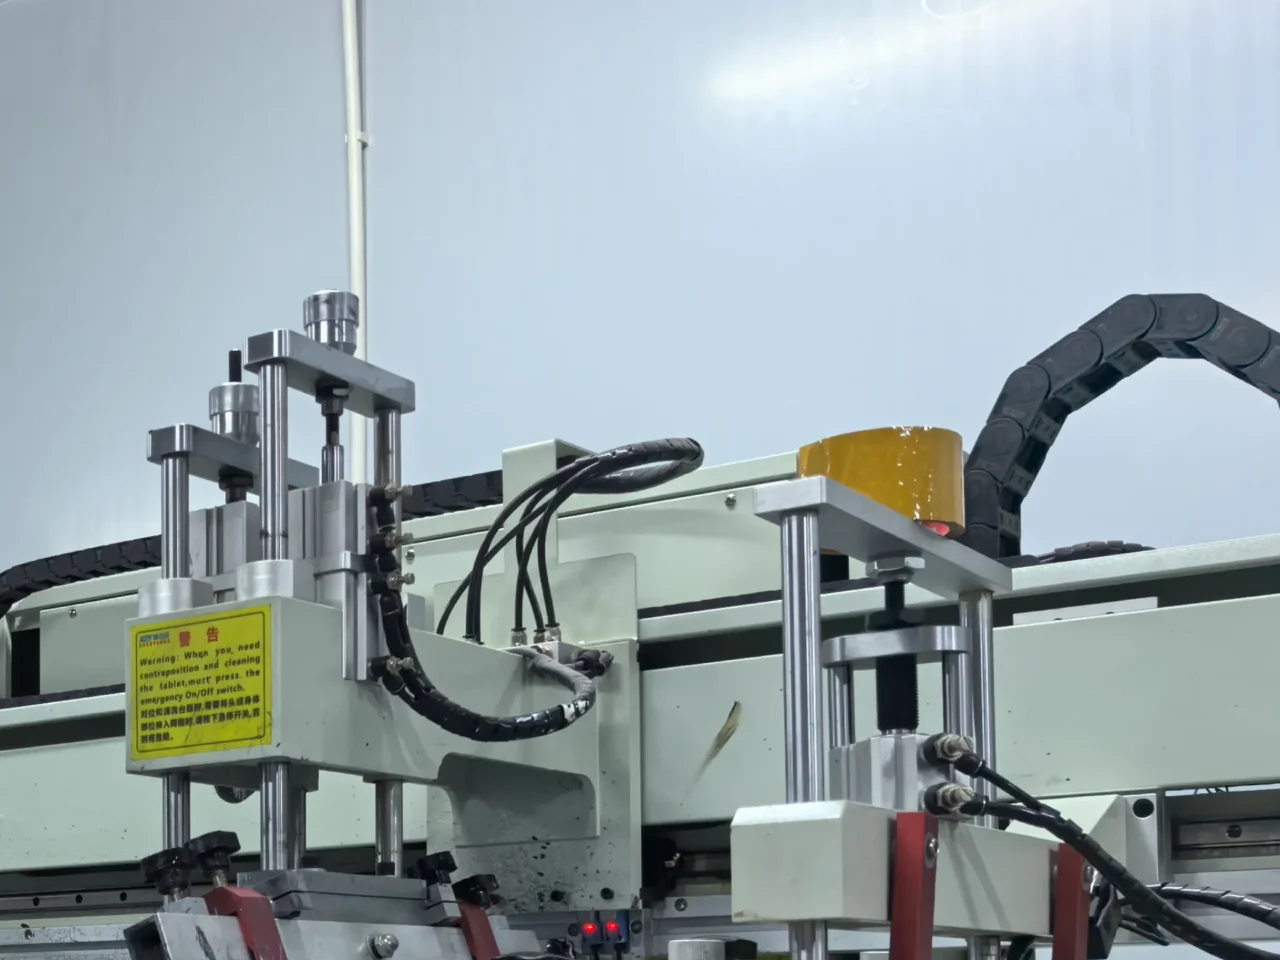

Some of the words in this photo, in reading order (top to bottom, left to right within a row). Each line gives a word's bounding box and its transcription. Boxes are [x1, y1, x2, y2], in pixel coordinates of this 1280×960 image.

[184, 650, 209, 660] When
[238, 640, 260, 652] need
[139, 664, 200, 680] contraposition
[203, 660, 219, 670] and
[224, 655, 261, 668] cleaning
[139, 683, 154, 693] the
[215, 671, 239, 683] press
[245, 668, 261, 678] the
[140, 693, 183, 705] emergency
[185, 687, 214, 700] On/Off
[216, 684, 245, 695] switch.
